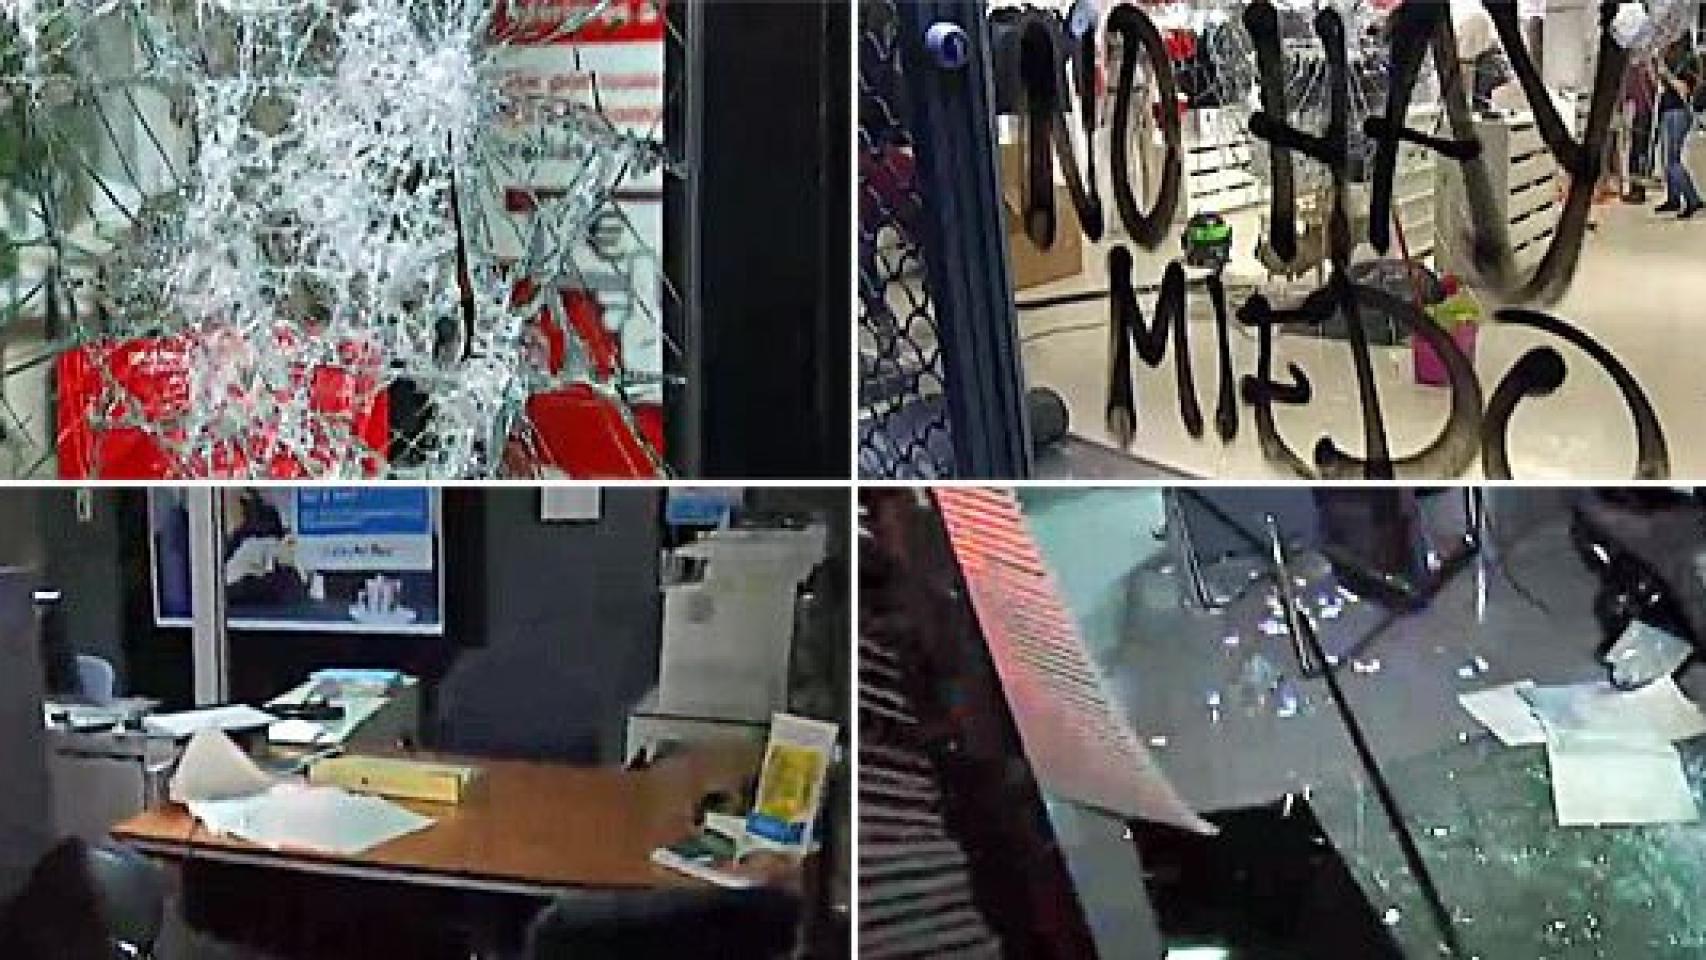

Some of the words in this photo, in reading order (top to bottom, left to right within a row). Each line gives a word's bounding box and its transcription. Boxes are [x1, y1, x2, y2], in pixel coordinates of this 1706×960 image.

[1021, 2, 1182, 252] NO
[1244, 0, 1627, 305] HAY
[1106, 245, 1670, 479] MIEDO
